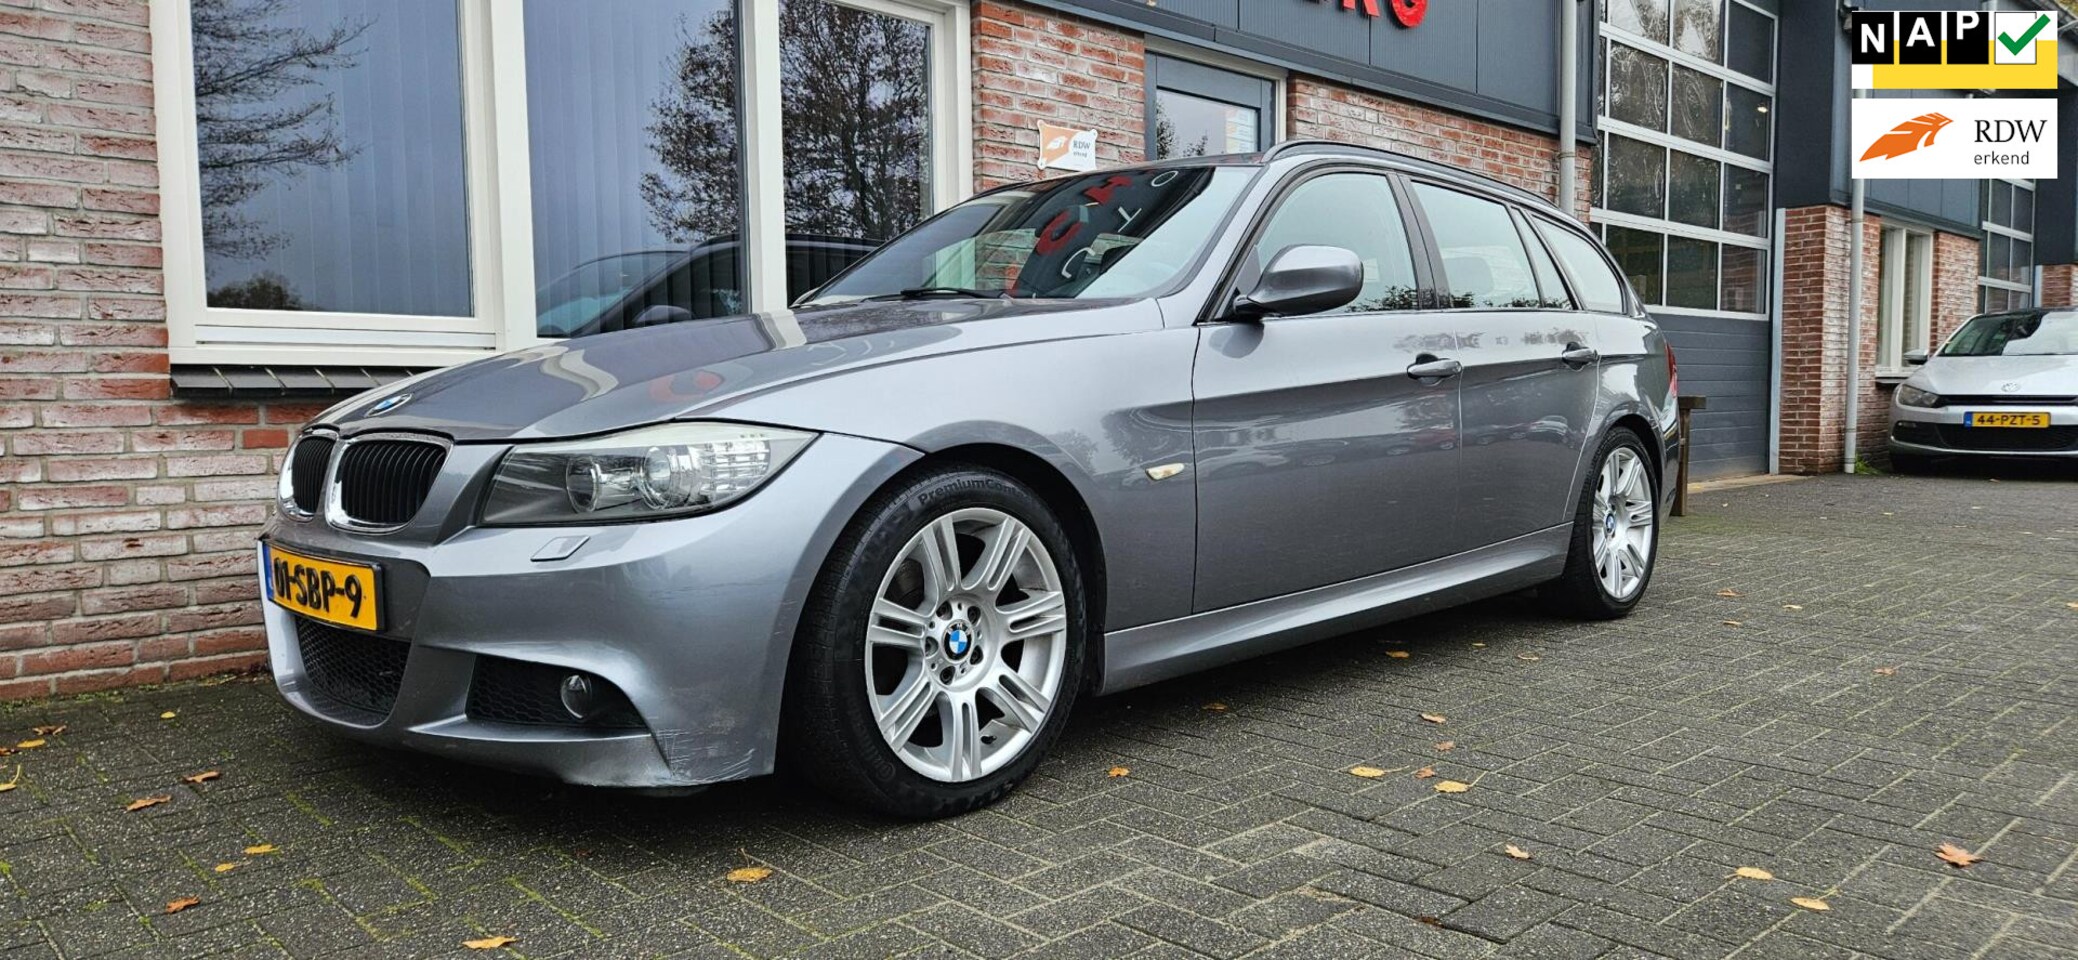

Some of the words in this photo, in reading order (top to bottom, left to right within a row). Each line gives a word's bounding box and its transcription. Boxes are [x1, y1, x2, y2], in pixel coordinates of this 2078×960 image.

[1977, 415, 2041, 425] 44-PZT-5
[918, 478, 1030, 505] PremiumCont
[273, 557, 362, 618] 01-SBP-9
